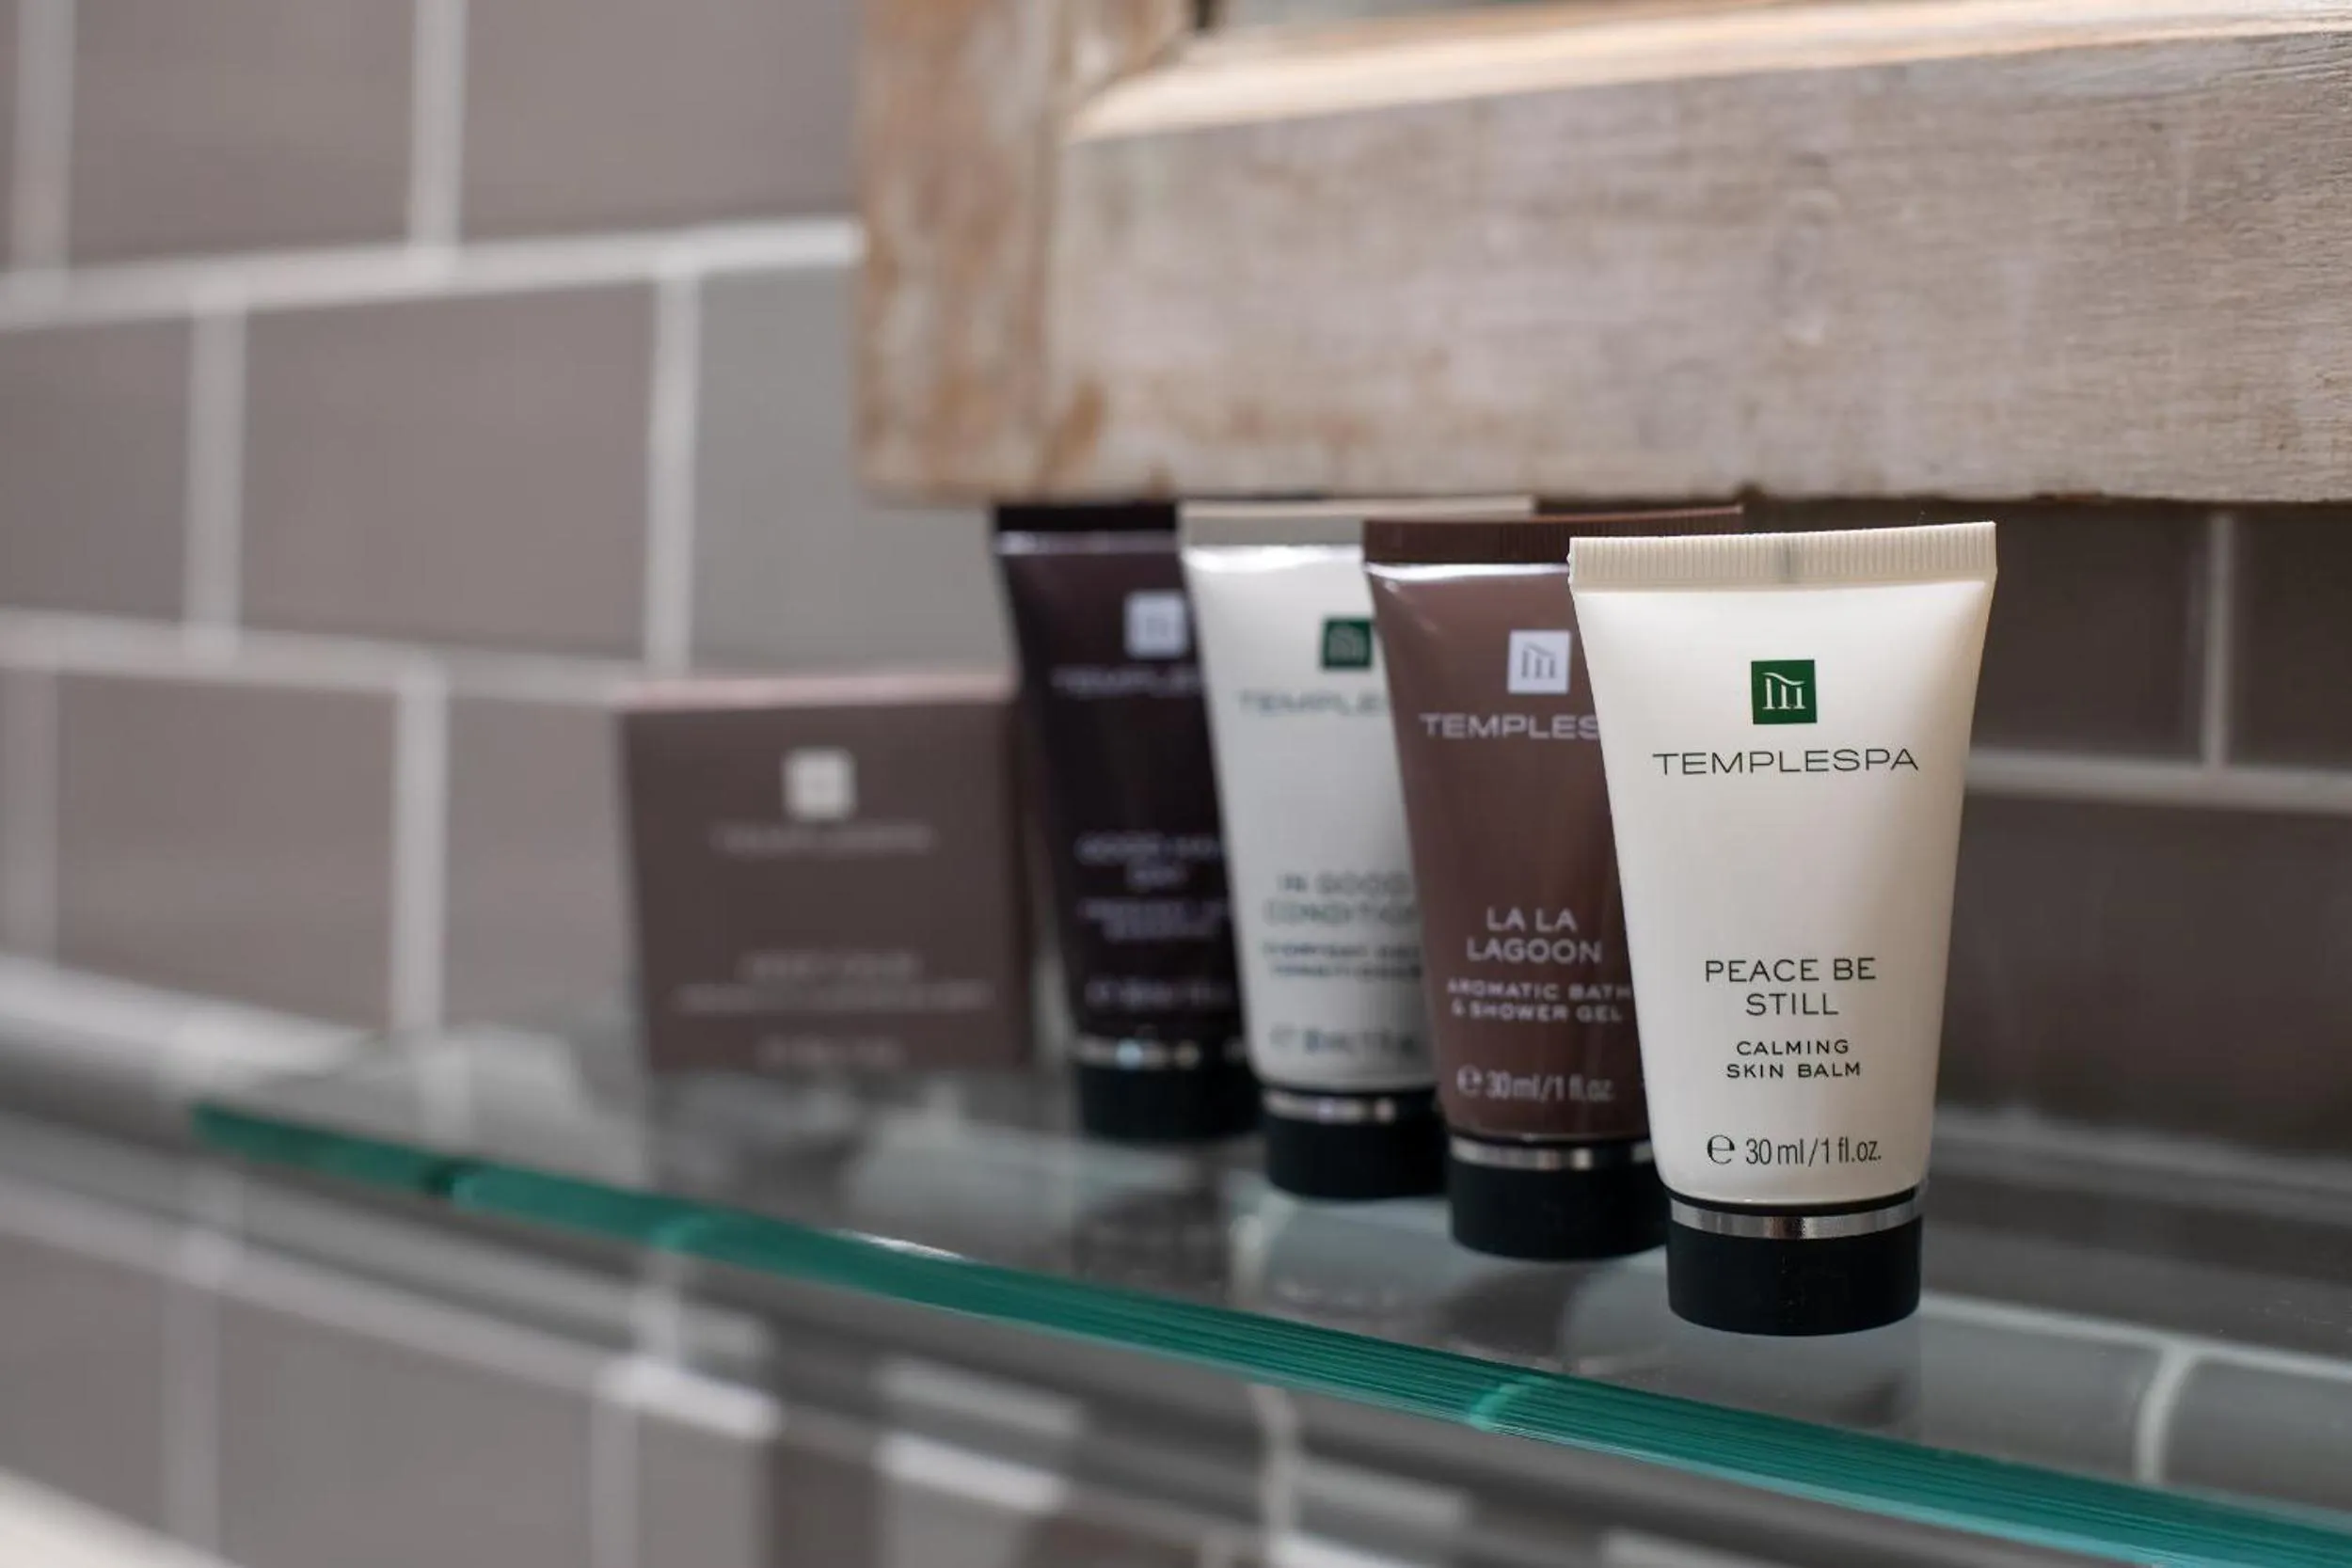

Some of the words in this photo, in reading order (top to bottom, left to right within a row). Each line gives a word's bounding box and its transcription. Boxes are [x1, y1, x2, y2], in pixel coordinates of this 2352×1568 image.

[1234, 689, 1390, 717] TEMPLE
[1419, 712, 1600, 739] TEMPLES
[1652, 749, 1919, 776] TEMPLESPA
[1486, 906, 1526, 931] LA
[1535, 908, 1578, 932] LA
[1466, 938, 1603, 964] LAGOON
[1705, 958, 1820, 983] PEACE
[1834, 957, 1877, 980] BE
[1447, 977, 1559, 1000] AROMATIC
[1469, 1001, 1570, 1022] SHOWER
[1576, 1004, 1623, 1022] GEL
[1745, 992, 1839, 1016] STILL
[1736, 1038, 1850, 1056] CALMING
[1726, 1063, 1784, 1079] SKIN
[1797, 1061, 1861, 1078] BALM
